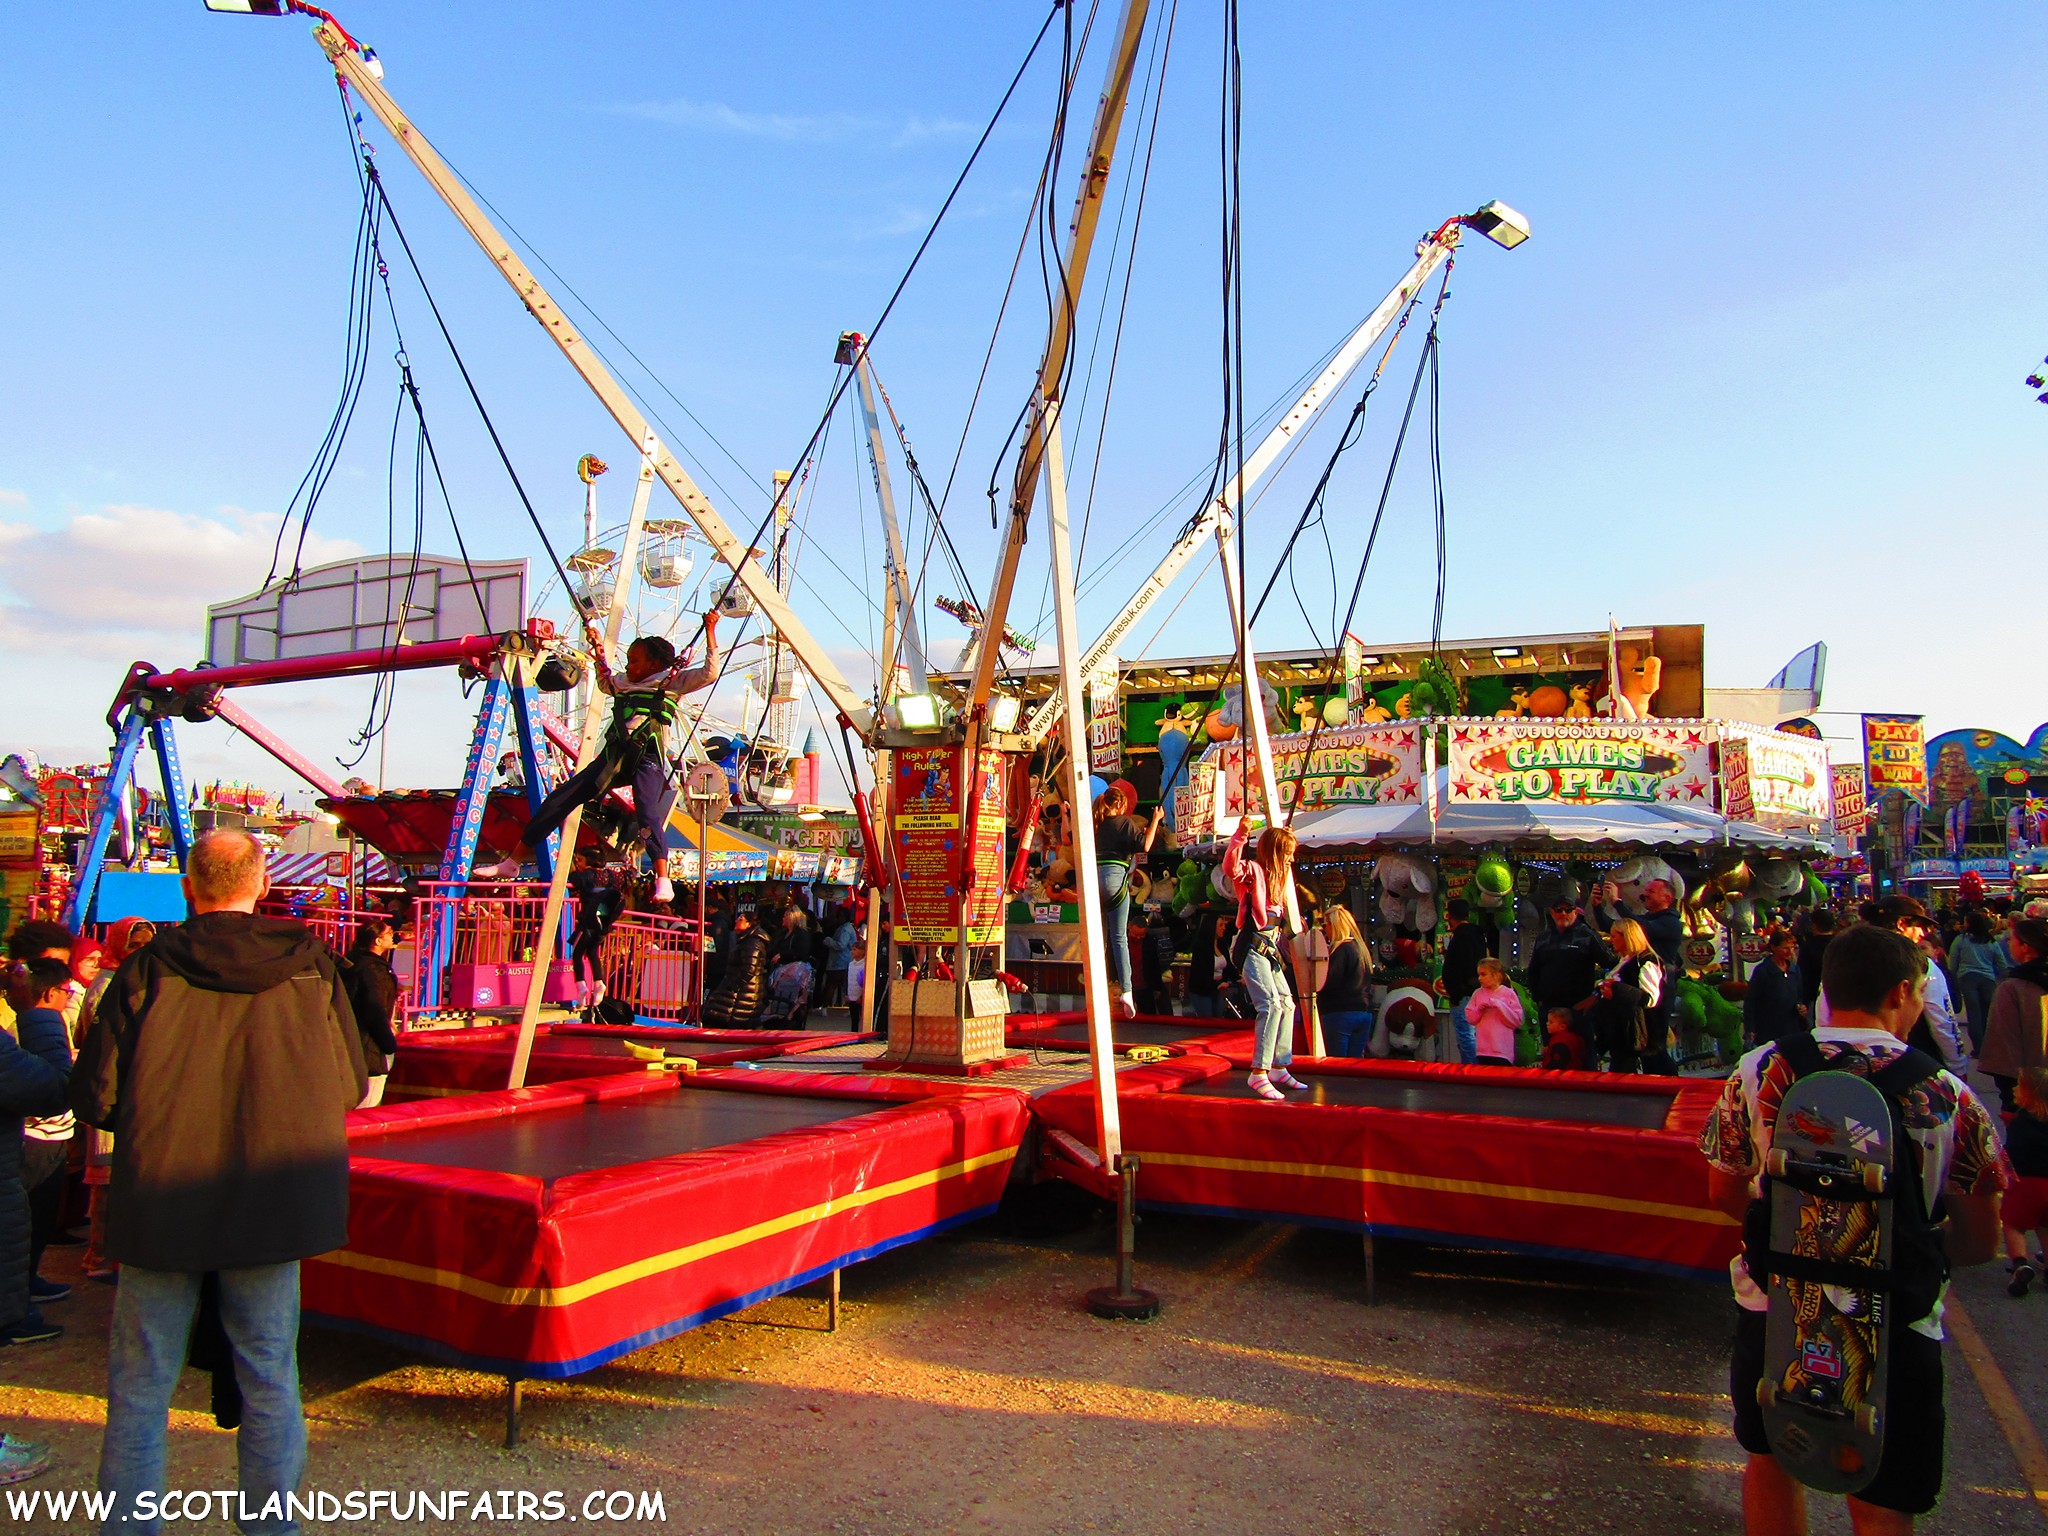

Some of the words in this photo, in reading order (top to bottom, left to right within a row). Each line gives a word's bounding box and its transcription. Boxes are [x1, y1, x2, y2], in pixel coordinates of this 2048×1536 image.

[1092, 720, 1119, 749] BIG
[1345, 734, 1363, 746] TO
[1514, 726, 1609, 739] WELCOME
[1618, 726, 1641, 738] TO
[1874, 725, 1914, 740] PLAY
[902, 751, 924, 761] High
[927, 750, 954, 761] Flyer
[1093, 749, 1119, 767] PRIZES
[1508, 740, 1646, 771] GAMES
[1886, 743, 1907, 759] TO
[914, 762, 942, 771] Rules
[1273, 748, 1369, 781] GAMES
[1726, 757, 1747, 781] WIN
[1881, 766, 1913, 782] WIN
[468, 743, 497, 824] SWING
[1190, 780, 1213, 798] WIN
[1302, 777, 1380, 805] PLAY
[1495, 769, 1553, 800] TO
[1561, 770, 1660, 802] PLAY
[1730, 778, 1750, 802] BIG
[1833, 779, 1862, 800] WIN
[1190, 796, 1214, 817] BIG
[1834, 797, 1862, 819] BIG
[1835, 816, 1864, 830] PRIZES
[438, 798, 468, 882] SWING
[764, 824, 865, 849] LEGEND
[687, 860, 726, 872] HOK
[740, 858, 764, 869] BAG
[1311, 855, 1340, 863] RING
[1343, 854, 1373, 862] TOSS
[1533, 852, 1570, 861] RING
[1574, 852, 1612, 861] TOSS
